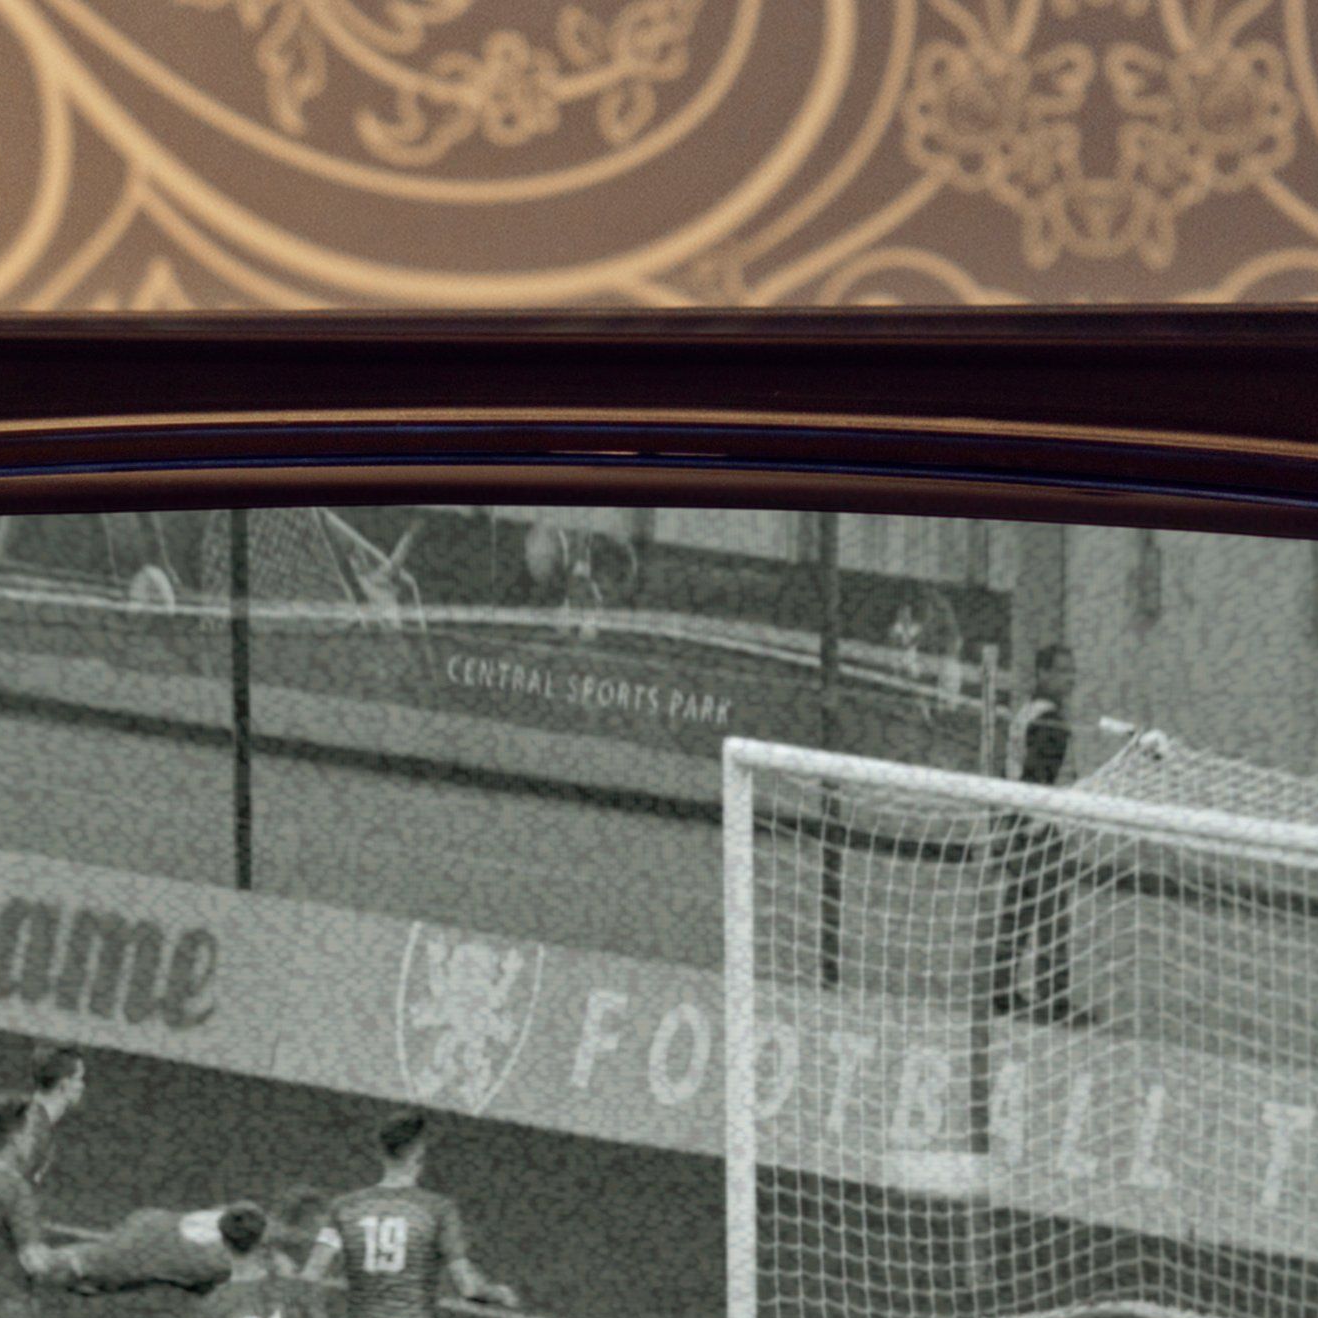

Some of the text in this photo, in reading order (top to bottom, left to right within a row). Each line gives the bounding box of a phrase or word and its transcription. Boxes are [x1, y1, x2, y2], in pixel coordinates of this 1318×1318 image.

[447, 654, 733, 725] CENTRAL SPORTS PARK
[569, 988, 1171, 1189] FOOTBALL
[358, 1214, 408, 1274] 19
